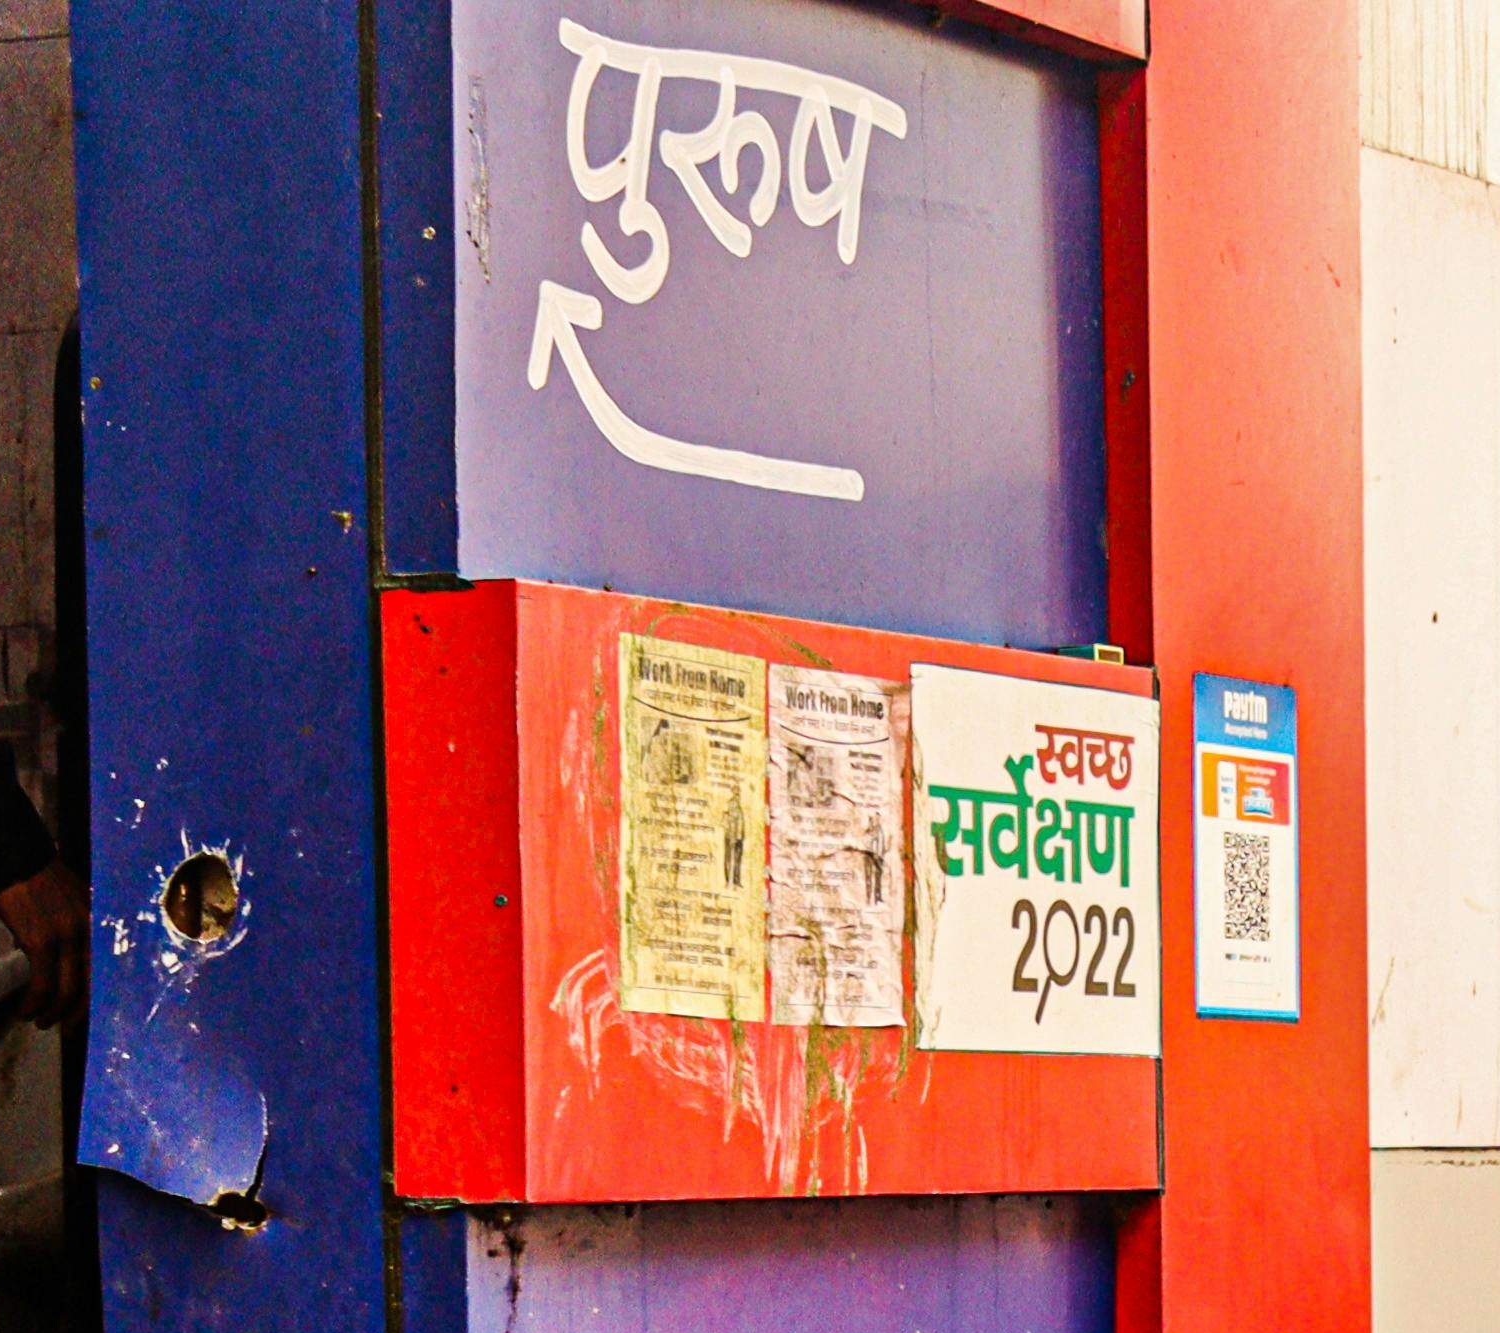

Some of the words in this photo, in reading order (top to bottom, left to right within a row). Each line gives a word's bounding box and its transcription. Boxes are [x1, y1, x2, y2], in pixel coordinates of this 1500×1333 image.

[638, 655, 673, 685] Work
[676, 663, 707, 690] From
[710, 669, 746, 699] Home
[785, 685, 818, 712] Work
[820, 691, 848, 715] From
[851, 693, 885, 720] Home
[1035, 723, 1135, 791] स्वच्छ
[929, 754, 1135, 888] सर्वेक्षण
[1011, 898, 1137, 1026] 2022
